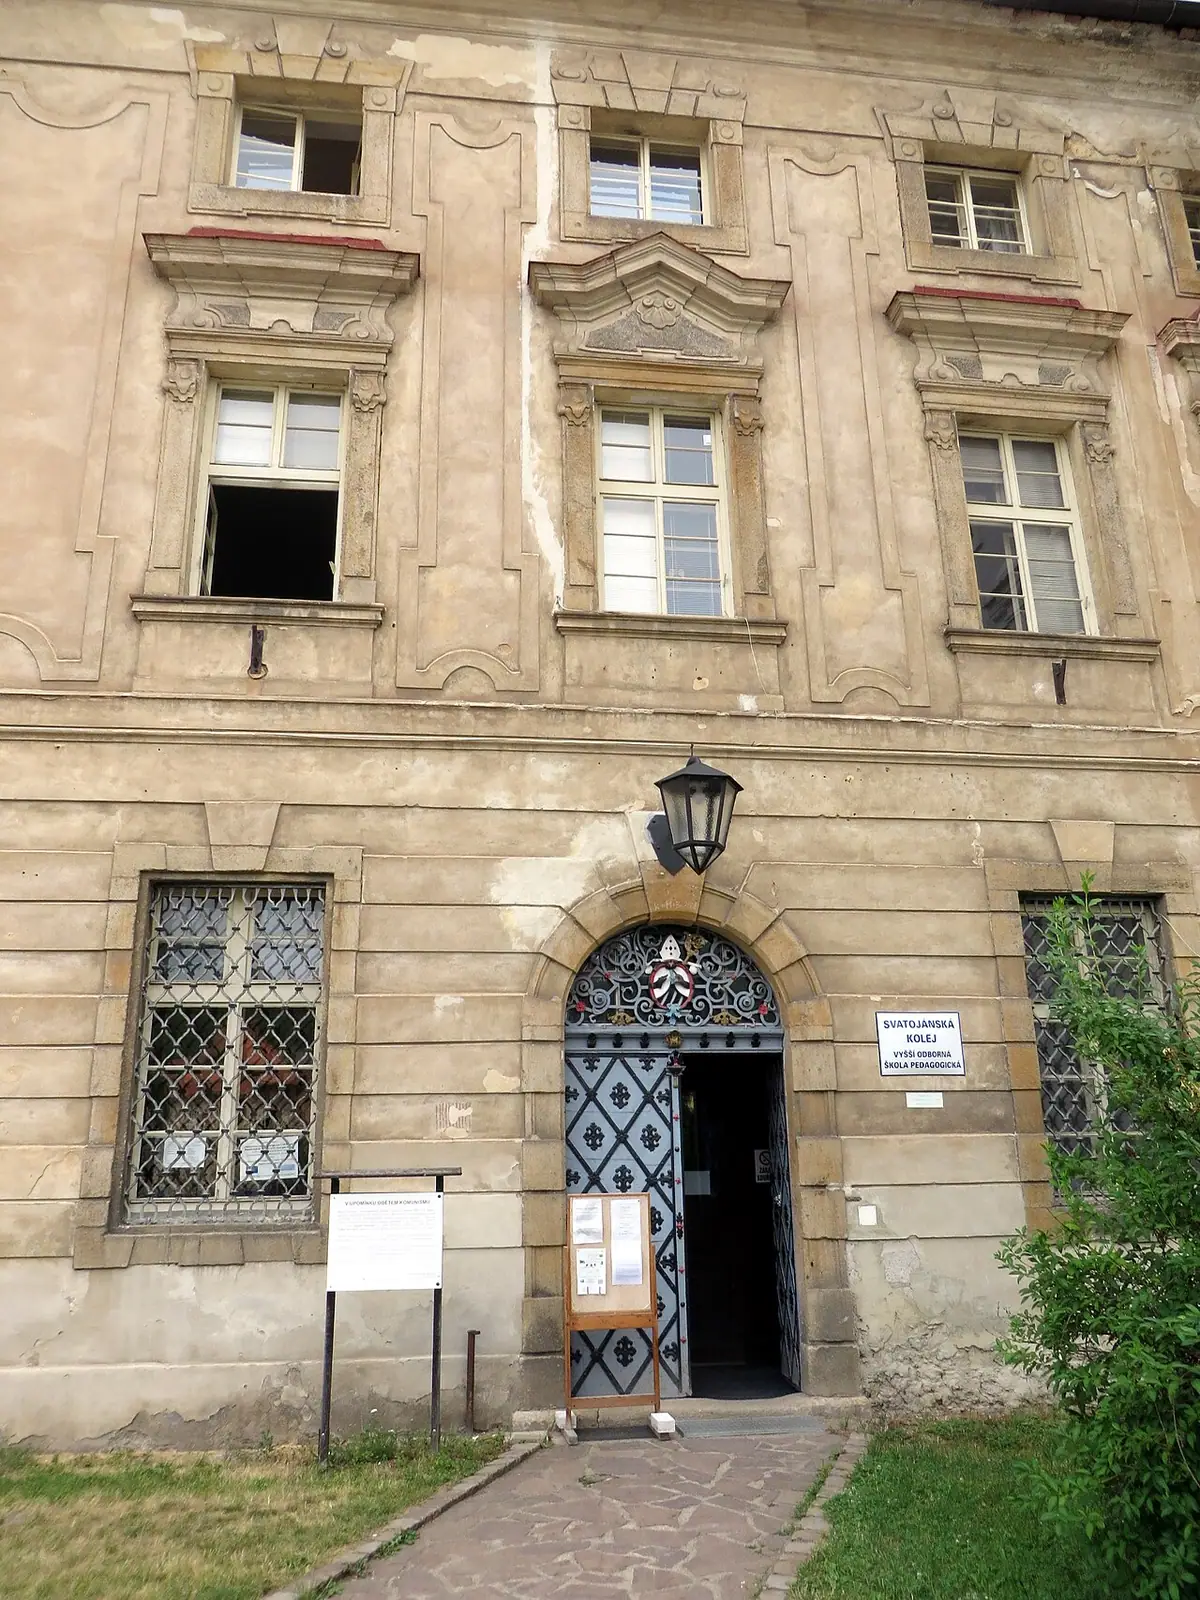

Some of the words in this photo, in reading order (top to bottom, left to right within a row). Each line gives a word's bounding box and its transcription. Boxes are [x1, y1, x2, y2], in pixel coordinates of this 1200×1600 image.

[883, 1018, 955, 1029] SVATOJÁNSKÁ
[906, 1034, 937, 1043] KOLEJ
[893, 1050, 915, 1058] VYŠŠÍ
[917, 1050, 952, 1058] ODBORNÁ
[884, 1060, 909, 1069] ŠKOLA
[910, 1060, 962, 1069] PEDAGOGICKÁ
